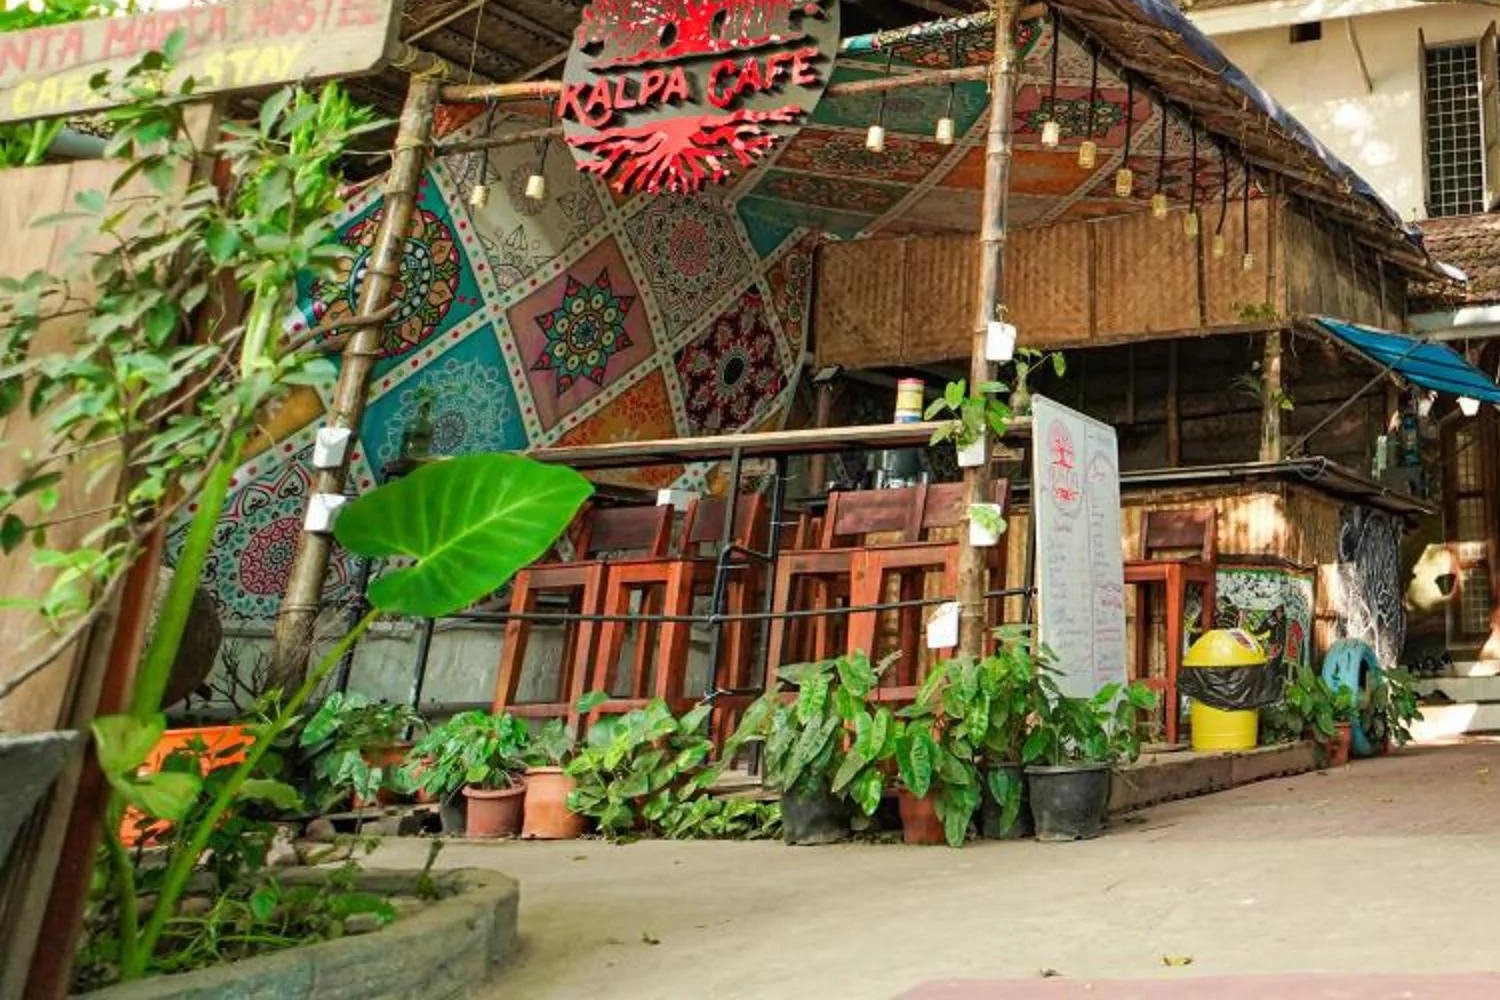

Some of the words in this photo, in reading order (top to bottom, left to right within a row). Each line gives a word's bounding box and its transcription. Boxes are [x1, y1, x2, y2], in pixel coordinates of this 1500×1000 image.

[203, 43, 303, 87] STAY
[557, 65, 690, 128] KALPA
[707, 47, 819, 108] CAFE
